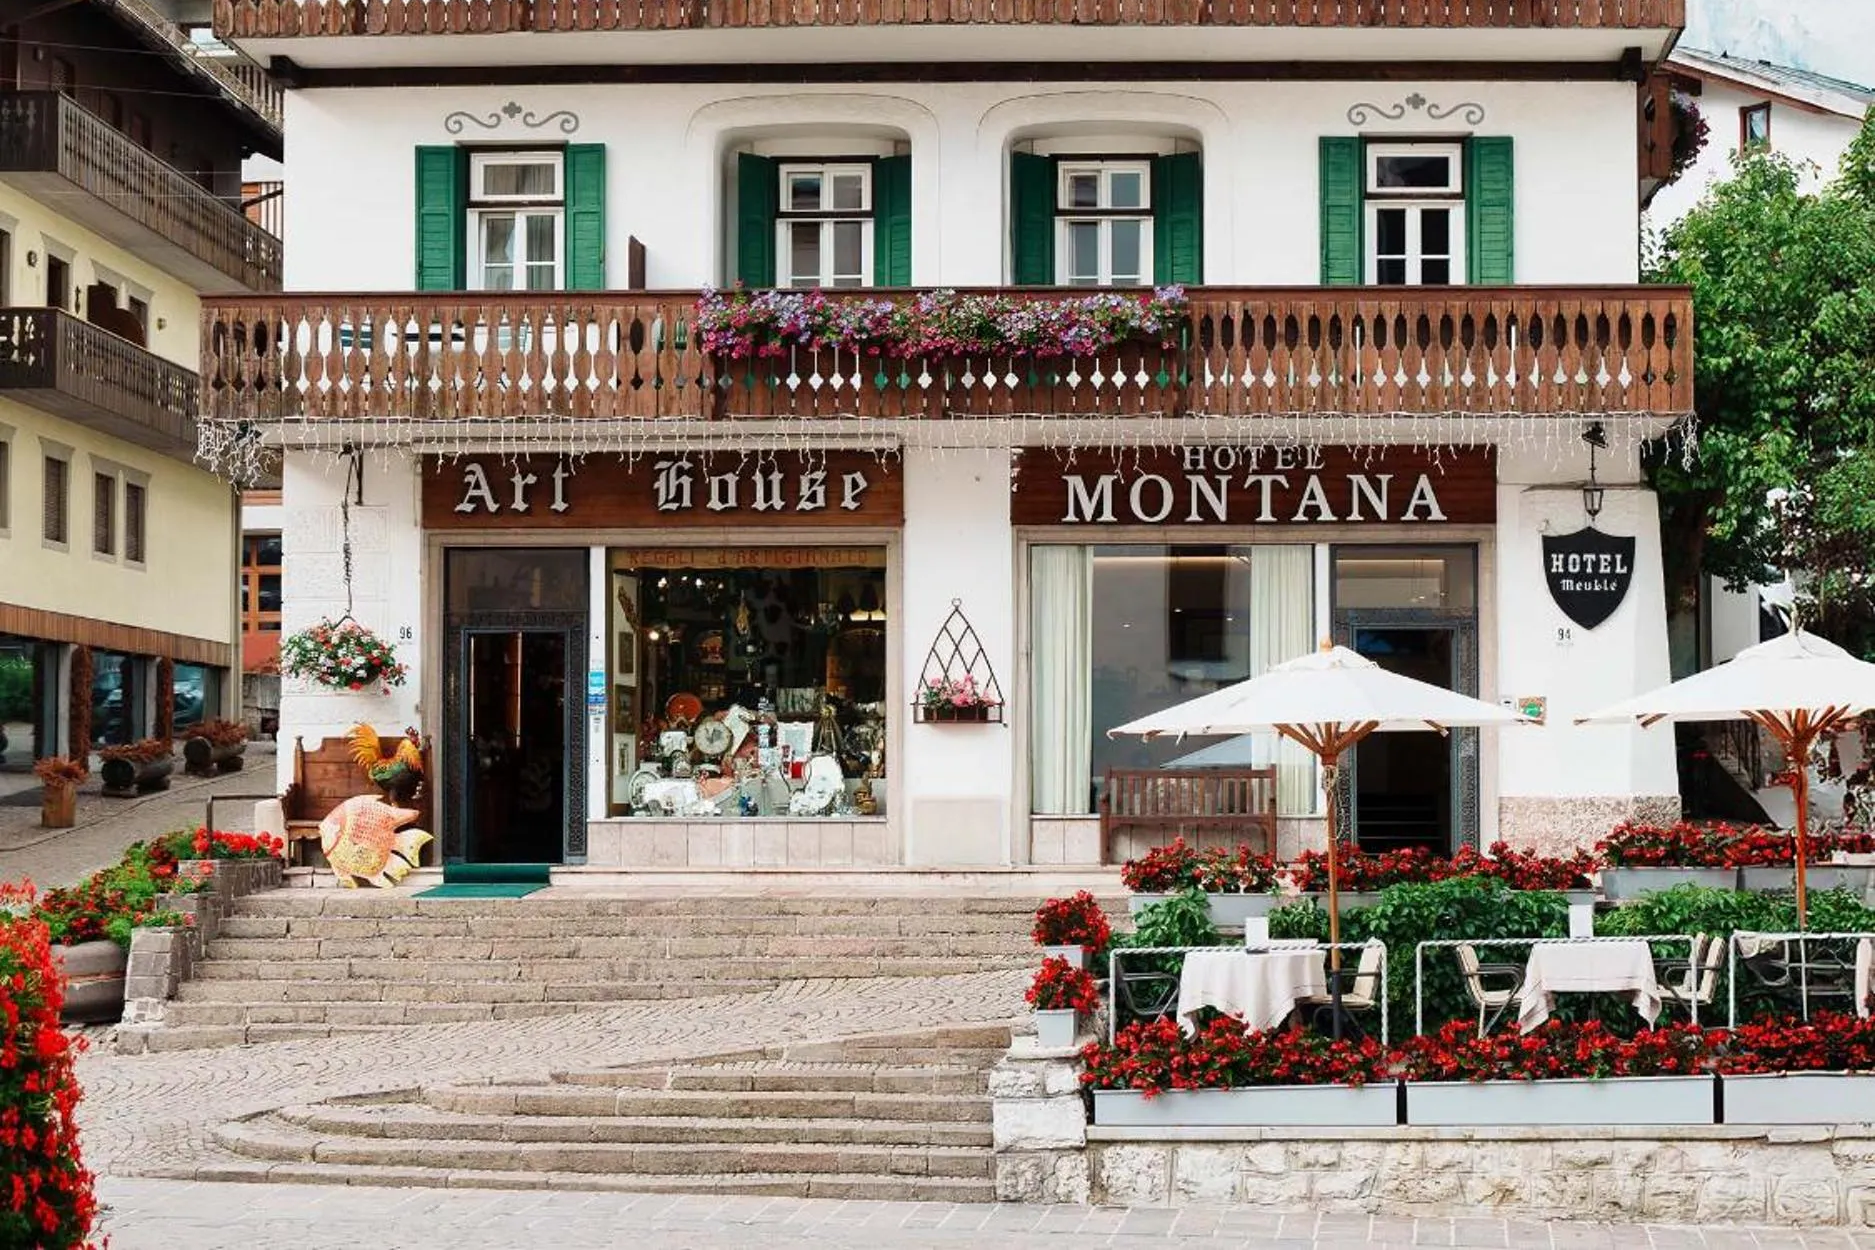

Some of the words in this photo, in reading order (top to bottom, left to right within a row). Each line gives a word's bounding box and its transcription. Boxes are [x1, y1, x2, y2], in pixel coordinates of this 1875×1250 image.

[1182, 445, 1326, 472] HOTEL
[454, 460, 569, 513] Art
[653, 460, 868, 511] House
[1061, 473, 1448, 523] MONTANA
[1550, 553, 1628, 574] HOTEL
[399, 625, 413, 639] 96
[1557, 627, 1572, 641] 94
